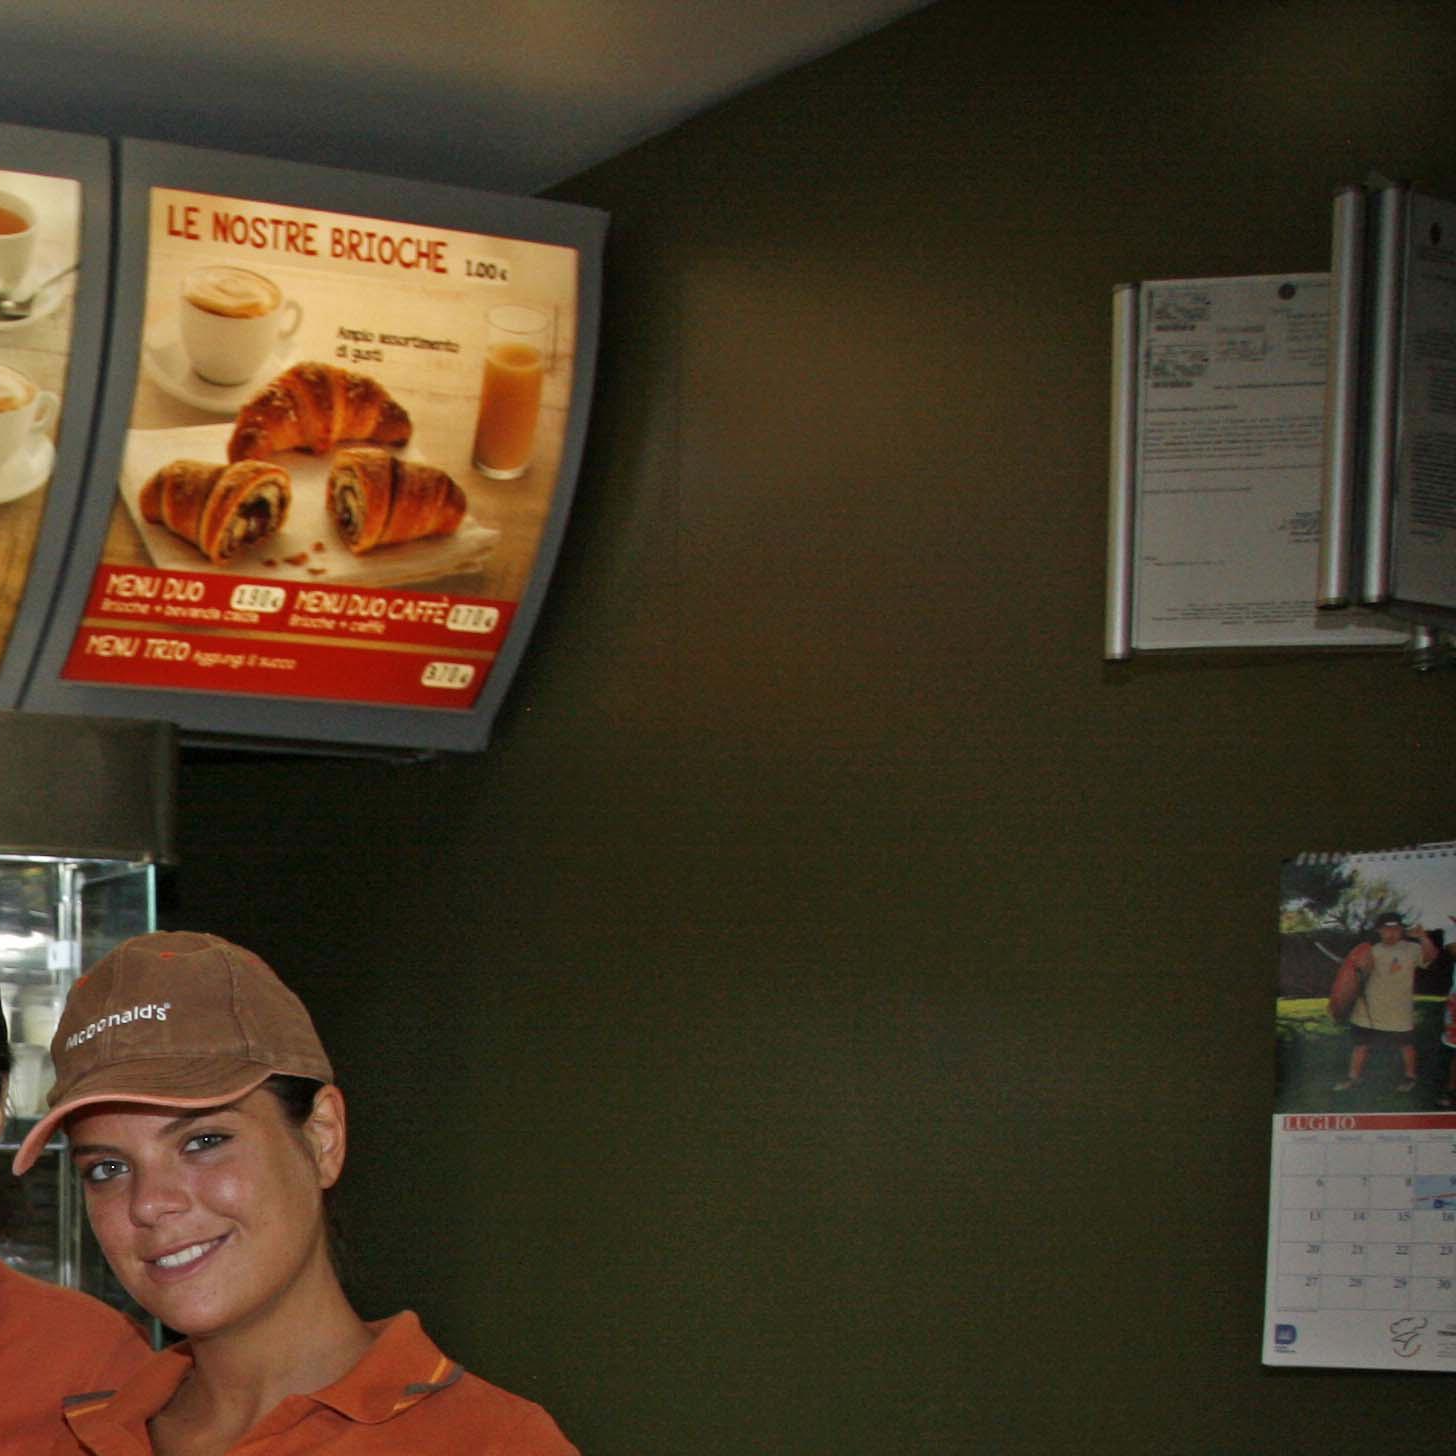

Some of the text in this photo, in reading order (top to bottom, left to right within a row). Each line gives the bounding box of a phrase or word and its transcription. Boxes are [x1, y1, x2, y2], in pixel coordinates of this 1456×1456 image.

[166, 205, 449, 275] LE NOSTRE BRIOCHE
[105, 573, 206, 603] MENU DUO
[294, 589, 348, 616] MENU
[347, 594, 388, 619] DUO
[85, 634, 141, 658] MENU
[143, 638, 192, 662] TRIO
[64, 1002, 172, 1050] McDonald's
[1283, 1116, 1357, 1131] LUGLIO
